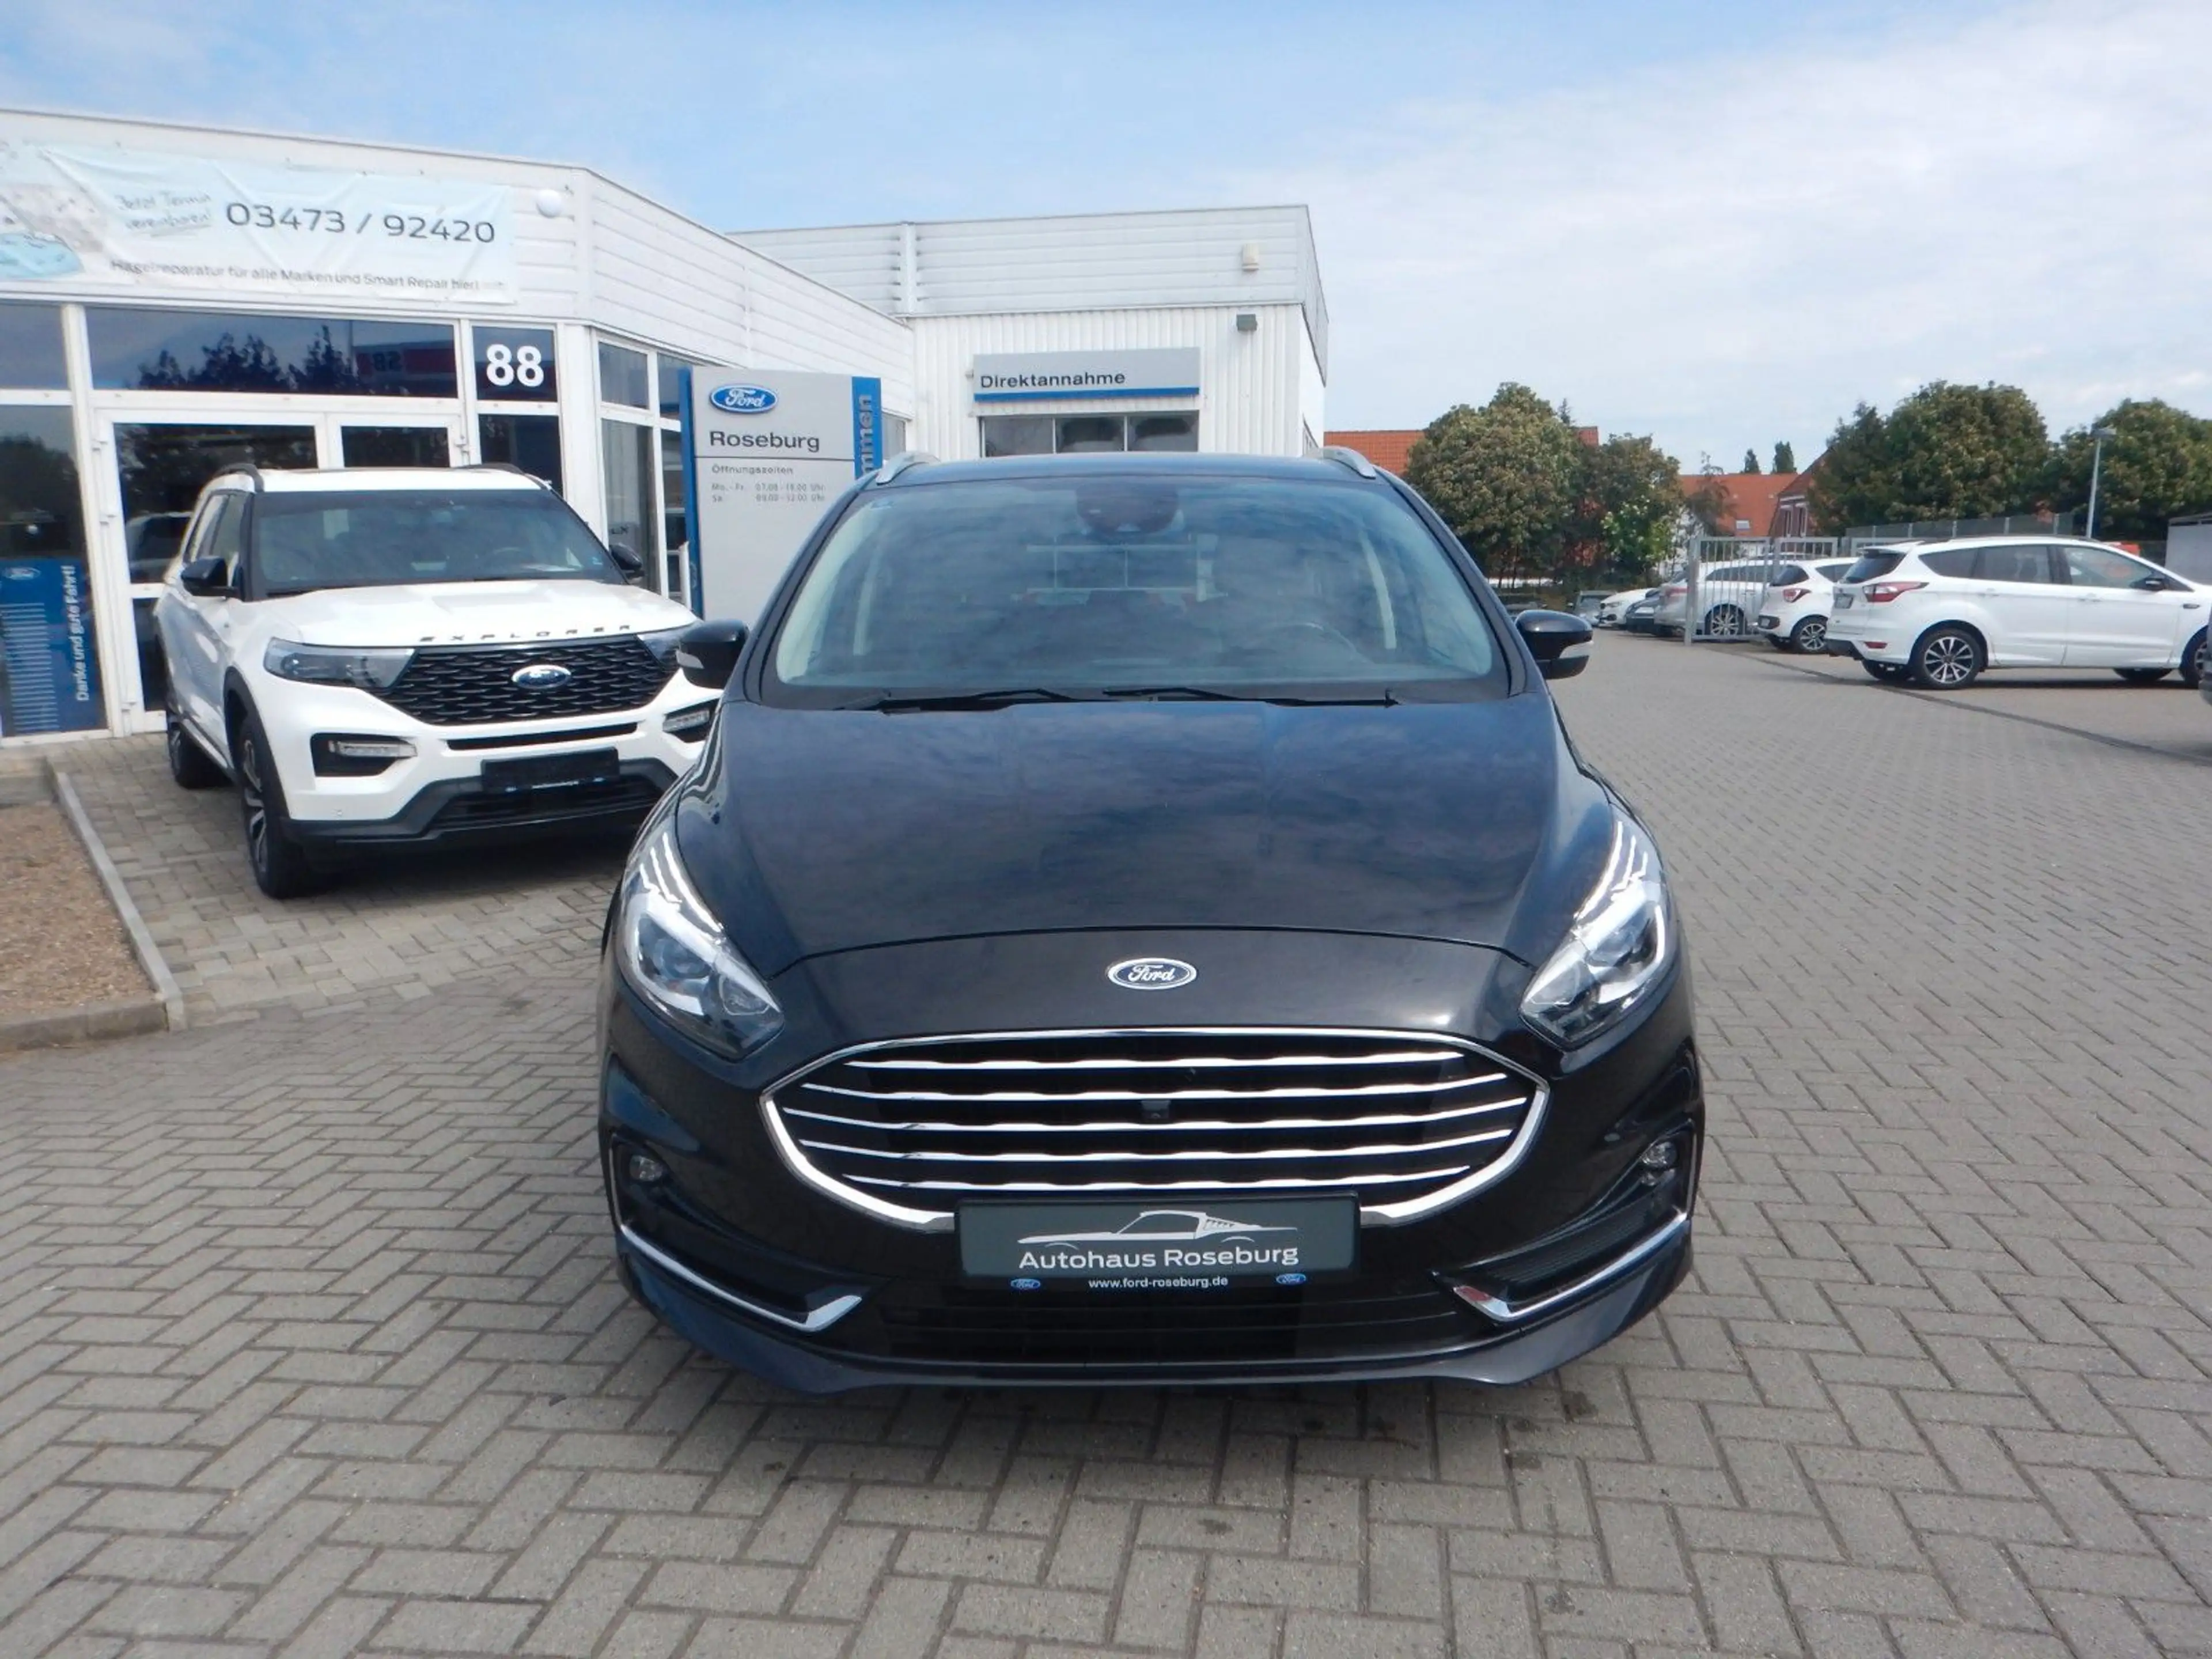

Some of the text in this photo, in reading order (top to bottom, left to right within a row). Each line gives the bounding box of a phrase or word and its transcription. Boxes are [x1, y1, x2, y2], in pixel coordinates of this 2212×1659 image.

[226, 203, 495, 243] 03473 / 92420
[281, 269, 331, 283] Marken
[335, 271, 360, 285] und
[364, 274, 404, 287] Smart
[408, 276, 447, 290] Repair
[486, 344, 544, 387] 88
[980, 372, 1126, 389] Direktannahme
[709, 431, 820, 453] Roseburg
[711, 464, 793, 475] Öffnungszeiten
[67, 605, 84, 634] gute
[419, 624, 630, 642] EXPLORER
[69, 637, 85, 660] und
[73, 662, 88, 700] Danke
[1018, 1246, 1299, 1269] Autohaus Roseburg
[1088, 1276, 1229, 1289] www.ford-roseburg.de
